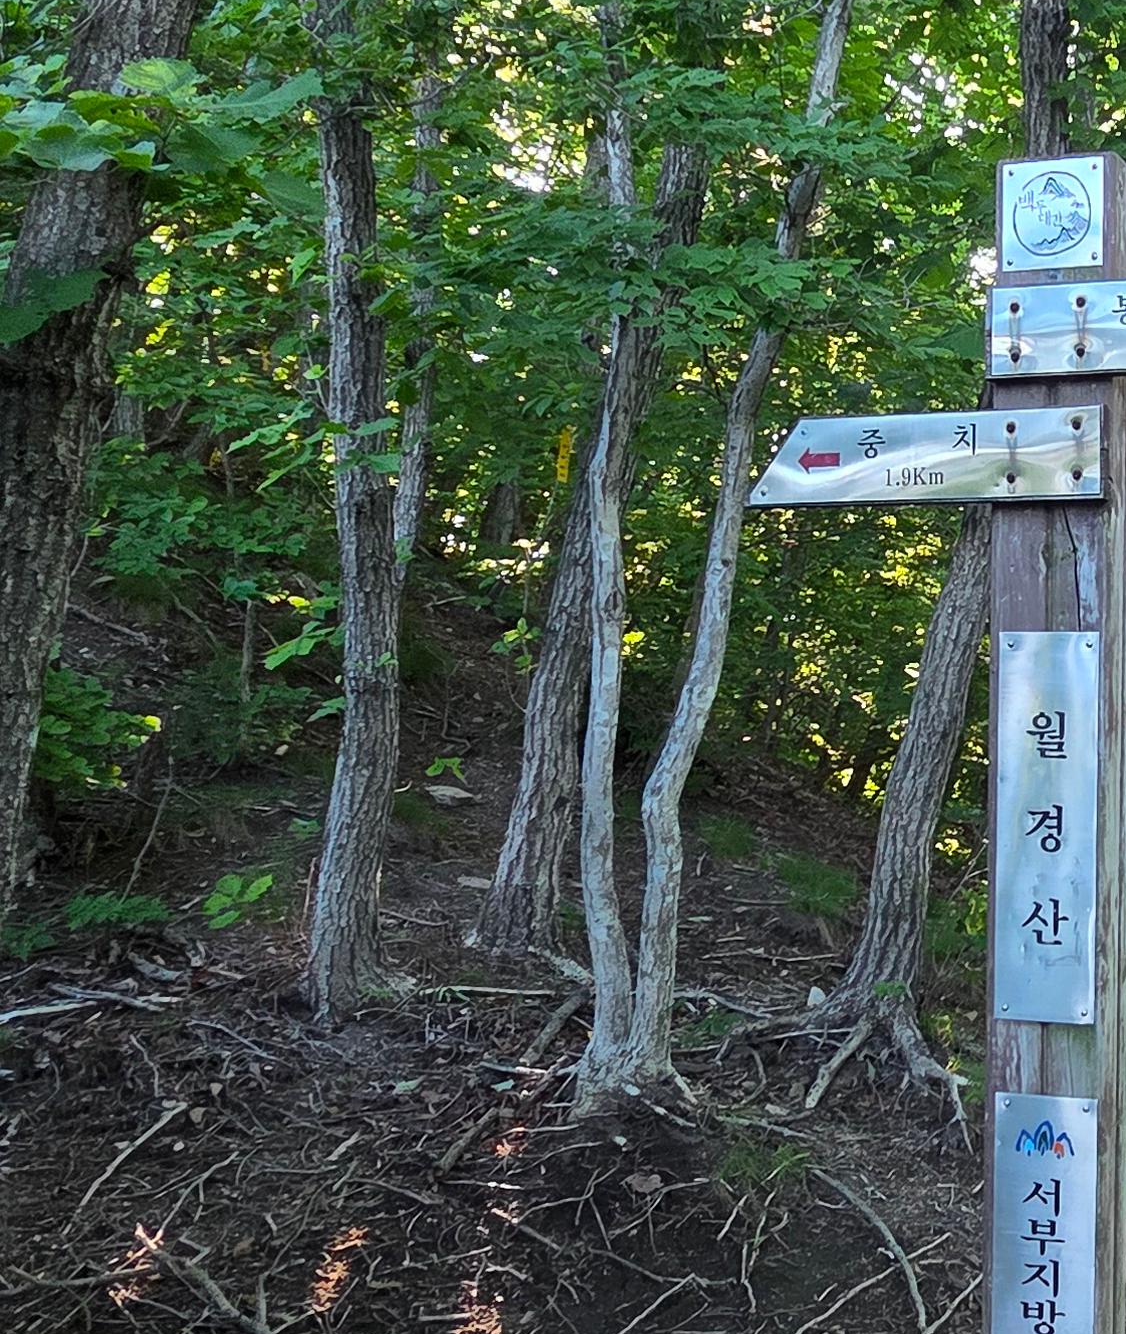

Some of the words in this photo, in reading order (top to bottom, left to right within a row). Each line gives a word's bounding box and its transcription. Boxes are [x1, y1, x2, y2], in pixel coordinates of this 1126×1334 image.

[857, 423, 977, 459] 중치
[885, 468, 945, 487] 1.9Km
[1022, 710, 1069, 946] 월경산
